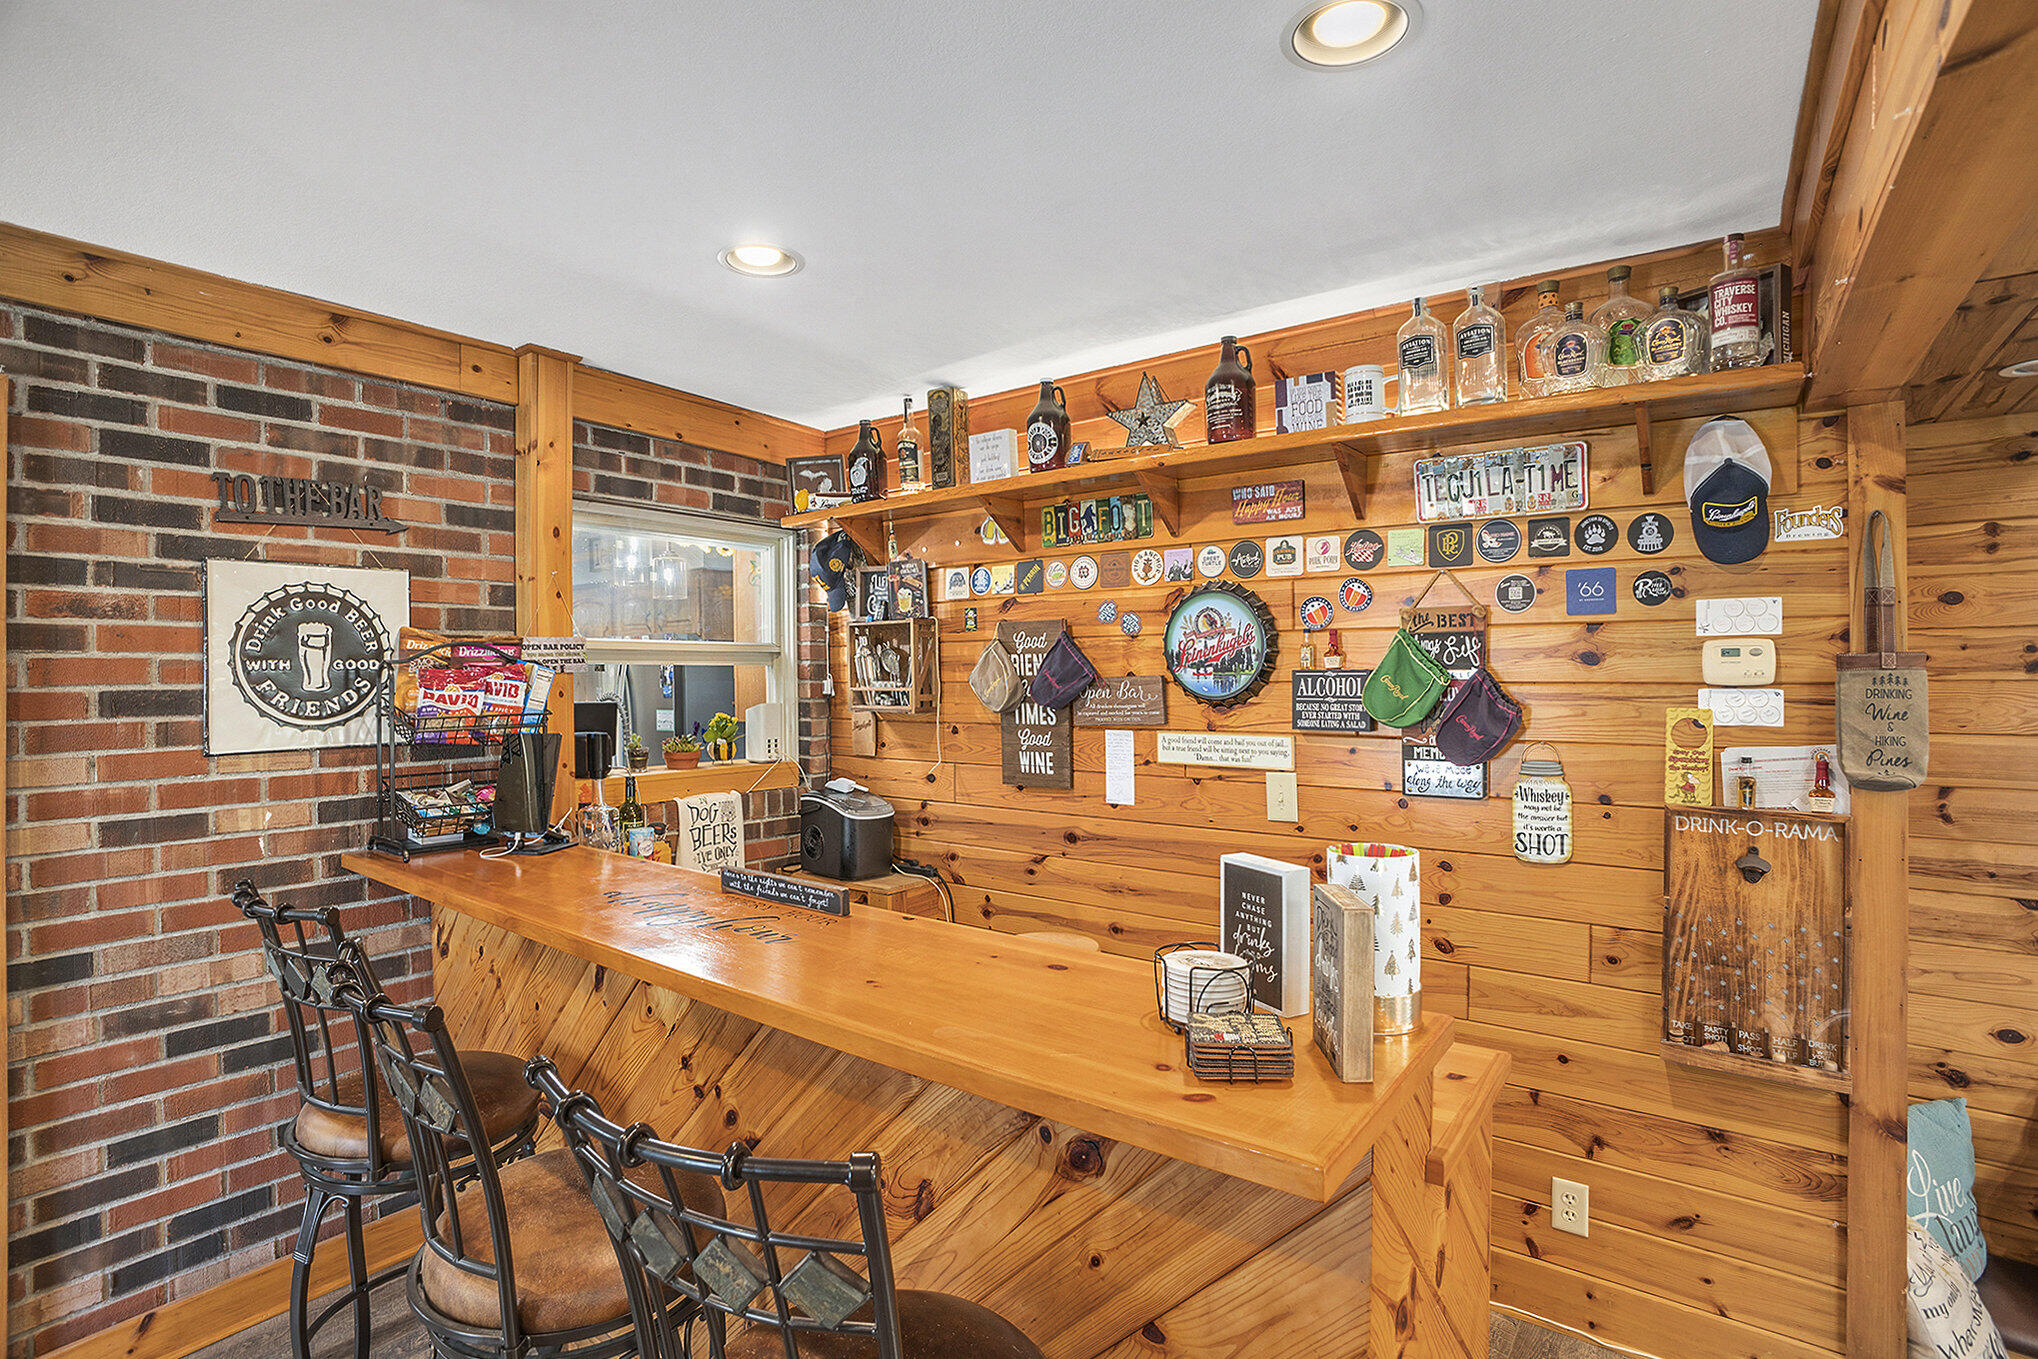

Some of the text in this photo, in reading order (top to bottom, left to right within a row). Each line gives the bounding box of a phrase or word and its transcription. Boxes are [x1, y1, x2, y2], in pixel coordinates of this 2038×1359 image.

[1714, 284, 1756, 298] TRAVERSE
[1714, 296, 1732, 309] CITY
[1714, 303, 1752, 318] WHISKEY
[1715, 316, 1727, 327] CO.
[1292, 399, 1322, 418] FOOD
[211, 472, 384, 521] TO THE BAR
[1233, 485, 1275, 500] WHO SAID
[1235, 488, 1299, 518] Happy Hour
[1776, 508, 1842, 538] Founders
[245, 597, 379, 653] Drink Good BEER
[1412, 612, 1474, 628] the BEST
[1013, 631, 1048, 653] Good
[1173, 622, 1256, 674] Leinenkugel's
[1414, 634, 1442, 658] ings
[246, 659, 380, 671] WITH GOOD
[1011, 653, 1047, 677] RIEN
[485, 682, 519, 698] AVID
[1117, 680, 1158, 701] Bar
[1297, 677, 1363, 697] ALCOHOL
[1865, 688, 1913, 700] DRINKING
[255, 677, 372, 717] FRIENDS
[422, 690, 479, 708] DAVID
[1014, 702, 1057, 726] TIMES
[1296, 703, 1319, 711] BECAUSE
[1321, 703, 1329, 711] NO
[1864, 703, 1909, 722] Wine
[1296, 719, 1320, 727] SOMEONE
[1321, 720, 1339, 728] EATING
[1302, 711, 1316, 719] EVER
[1343, 712, 1360, 720] WITH
[1887, 723, 1894, 732] &
[1018, 728, 1053, 750] Good
[1224, 738, 1233, 746] and
[1874, 736, 1906, 747] HIKING
[1221, 746, 1238, 755] sitting
[1865, 749, 1913, 768] Pines
[1018, 752, 1054, 774] WINE
[1406, 772, 1482, 793] along the way
[1518, 785, 1564, 805] Whiskey
[687, 803, 719, 827] DOG
[1518, 812, 1528, 820] the
[1524, 805, 1540, 813] may
[689, 823, 737, 851] BEERS
[1674, 816, 1839, 842] DRINK-O-RAMA
[1514, 832, 1569, 856] SHOT
[715, 845, 737, 860] ONLY
[744, 883, 754, 891] the
[756, 886, 779, 897] friends
[748, 874, 758, 883] the
[804, 887, 835, 898] remember
[1242, 892, 1265, 904] NEVER
[1242, 902, 1265, 915] CHASE
[1235, 911, 1272, 928] ANYTHING
[1247, 924, 1260, 934] BUT
[1233, 924, 1274, 957] drinks
[1671, 1020, 1693, 1030] TAKE
[1704, 1025, 1729, 1036] PARTY
[1738, 1030, 1761, 1041] PASS
[1772, 1037, 1798, 1047] HALF
[1738, 1044, 1763, 1053] SHOT
[1809, 1040, 1837, 1051] DRINK
[1922, 1303, 1949, 1319] my
